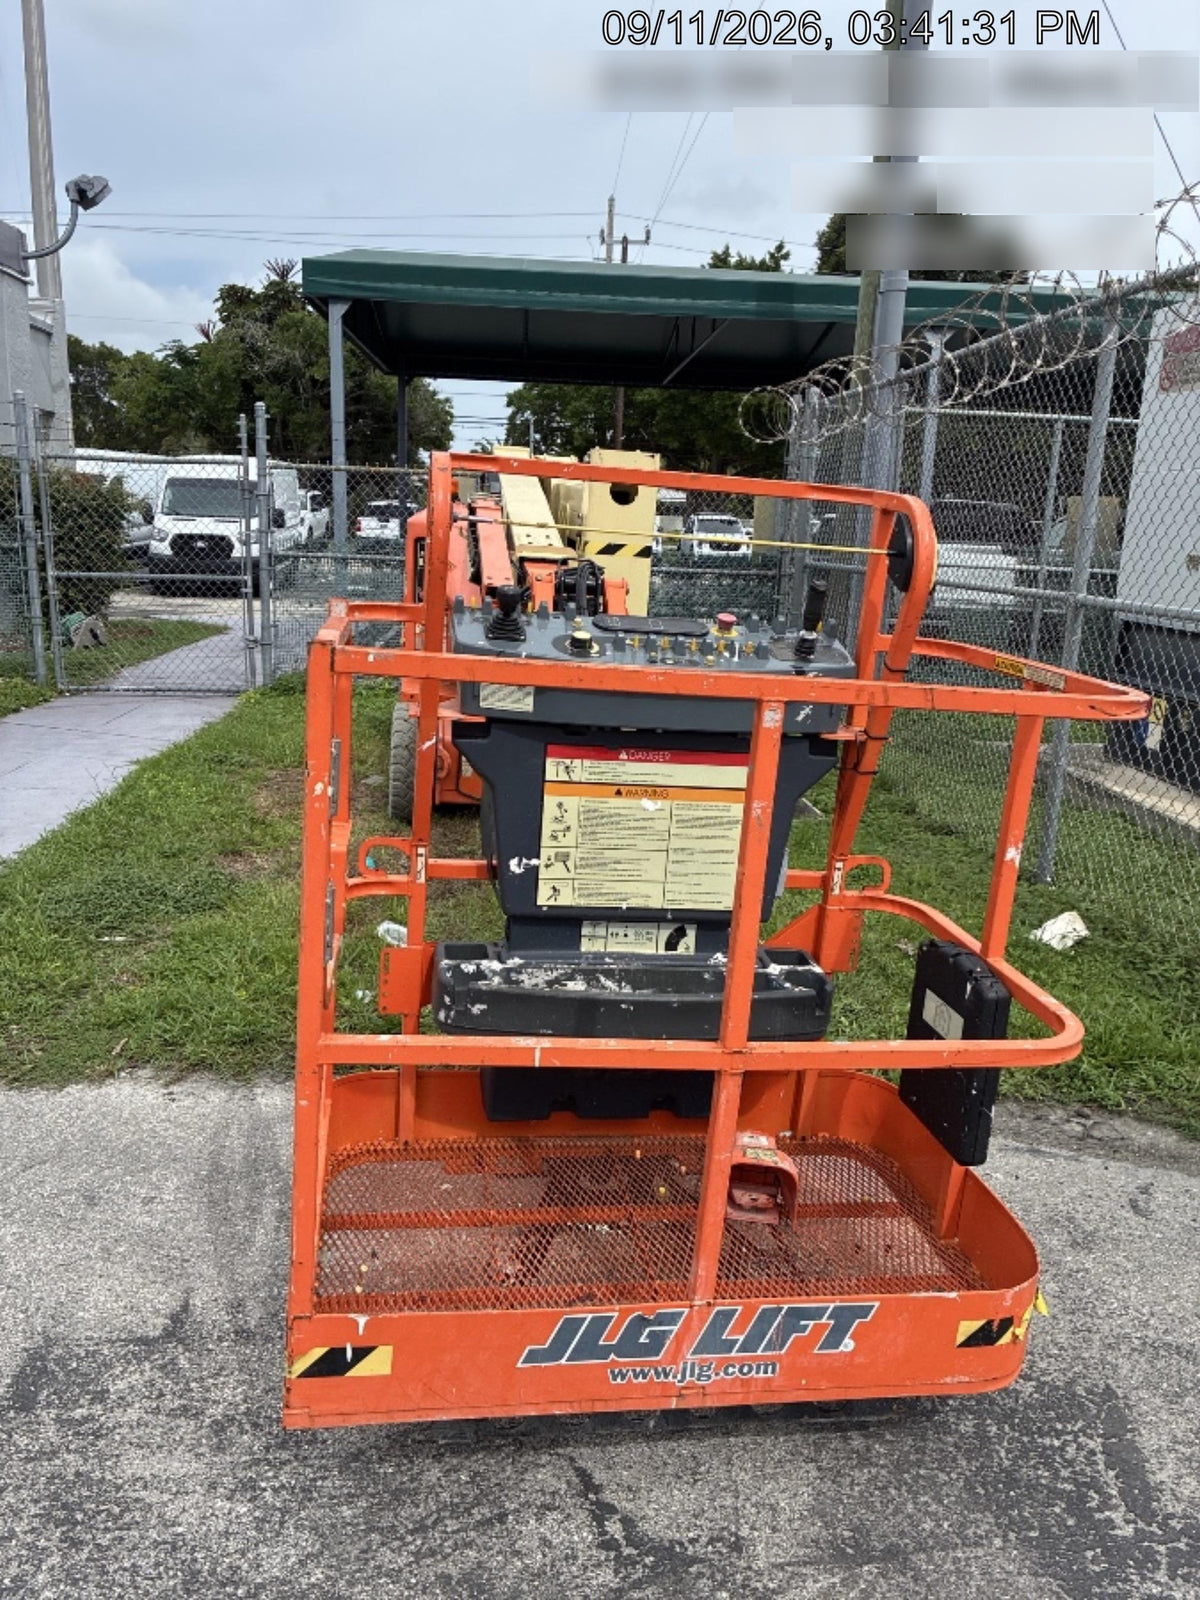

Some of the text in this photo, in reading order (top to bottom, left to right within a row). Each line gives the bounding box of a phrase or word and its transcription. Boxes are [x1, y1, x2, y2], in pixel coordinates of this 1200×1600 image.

[628, 749, 671, 762] DANGER
[625, 788, 670, 799] WARNING
[517, 1302, 880, 1367] JLG LIFT
[608, 1359, 778, 1385] www.jlg.com
